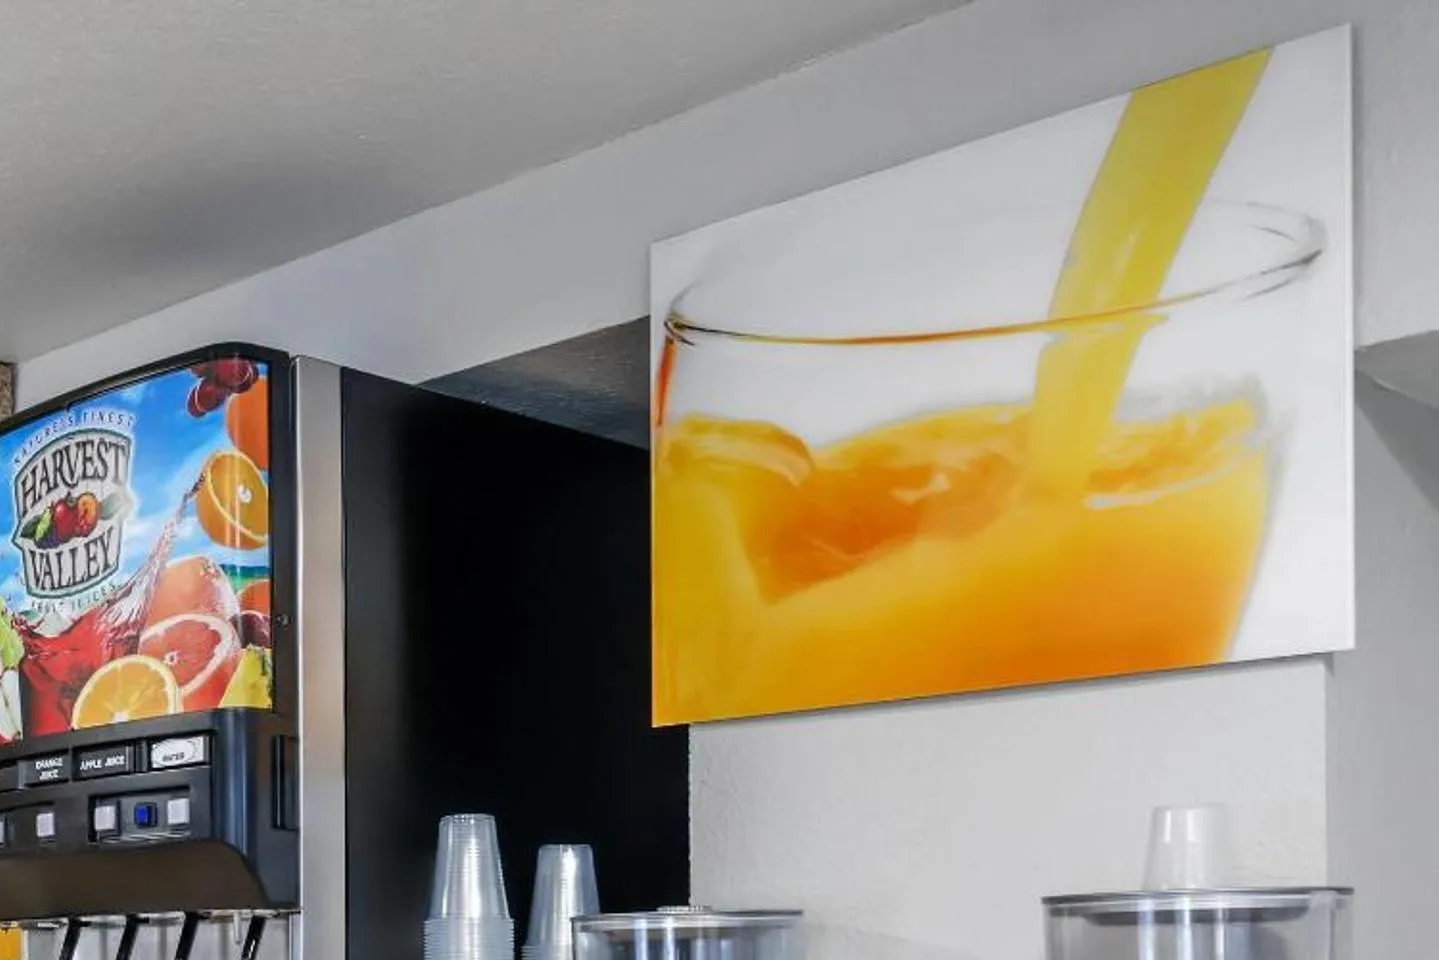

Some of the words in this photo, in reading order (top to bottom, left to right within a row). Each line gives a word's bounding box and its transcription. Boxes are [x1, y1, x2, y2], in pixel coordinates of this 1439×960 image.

[83, 410, 135, 427] FINEST
[20, 437, 128, 518] HARVEST
[29, 523, 114, 592] VALLEY
[35, 757, 63, 770] ORANGE
[80, 759, 102, 770] APPLE
[104, 755, 125, 767] JUICE
[39, 769, 59, 781] JUICE
